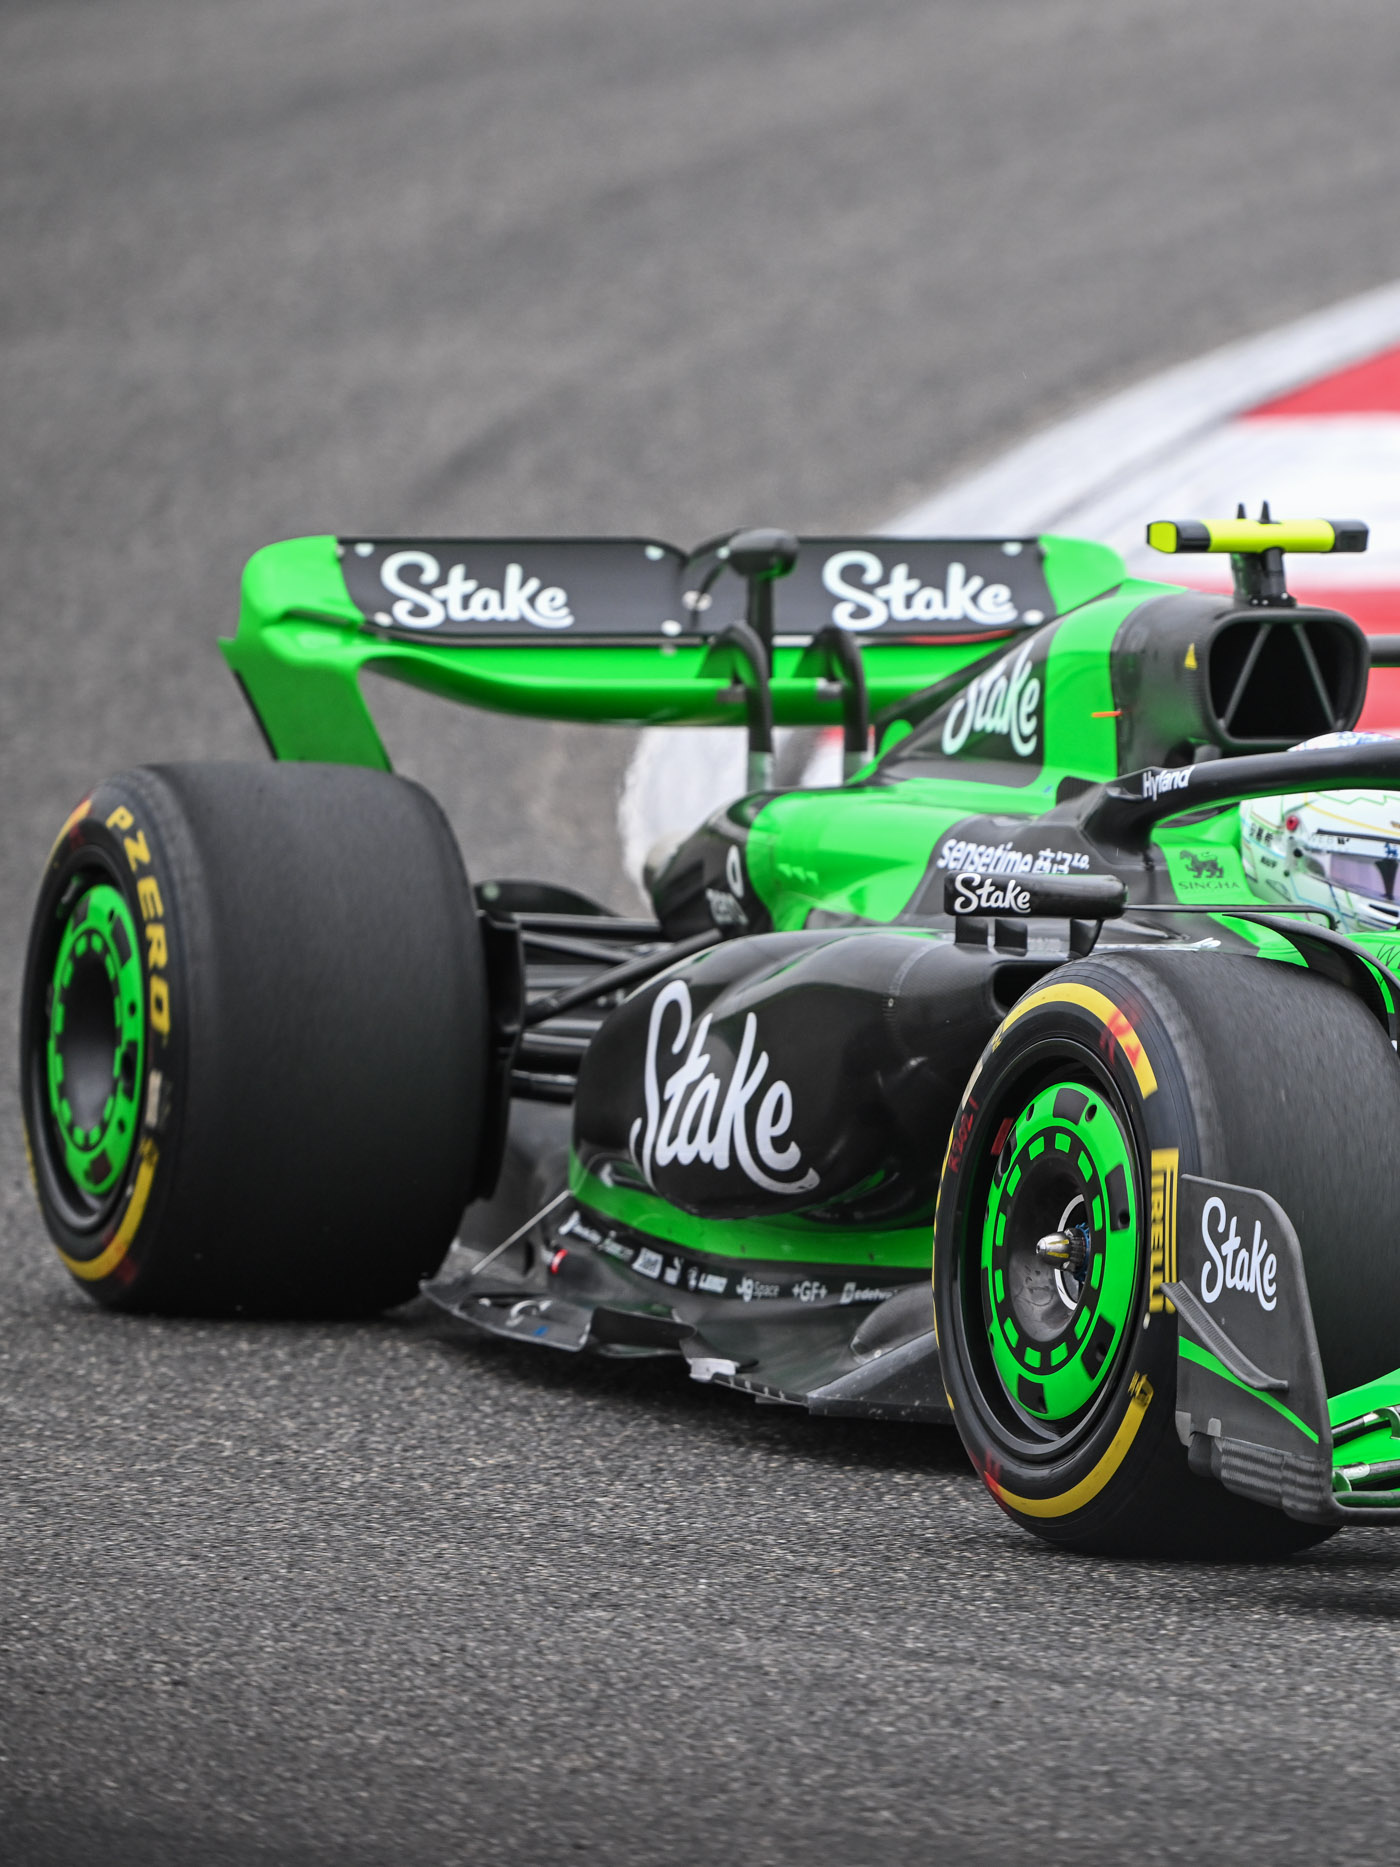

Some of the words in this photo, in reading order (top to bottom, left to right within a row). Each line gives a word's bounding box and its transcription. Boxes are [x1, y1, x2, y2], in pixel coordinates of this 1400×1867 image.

[380, 550, 575, 629] Stake
[822, 550, 1018, 631] Stake
[942, 639, 1040, 756] Stake
[1143, 765, 1196, 802] Hyland
[954, 872, 1031, 914] Stake
[629, 979, 820, 1194] Stake
[1201, 1196, 1277, 1311] Stake
